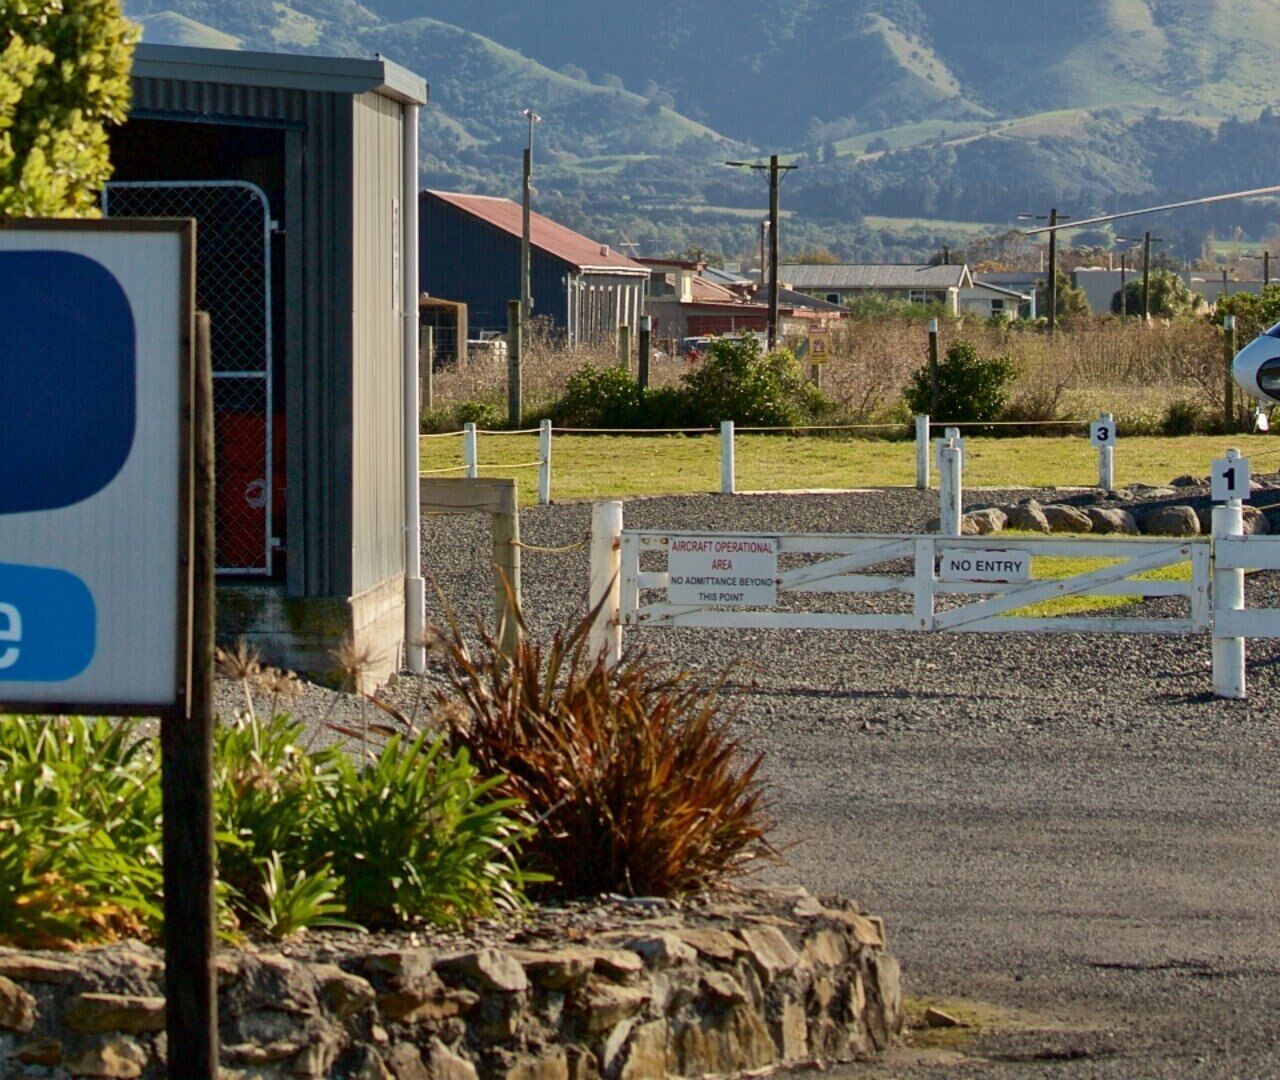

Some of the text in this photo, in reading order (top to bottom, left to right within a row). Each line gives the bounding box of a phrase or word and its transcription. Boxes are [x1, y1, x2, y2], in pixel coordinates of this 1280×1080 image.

[1096, 426, 1109, 441] 3
[1222, 467, 1236, 491] 1
[671, 540, 773, 553] AIRCRAFT OPERATIONAL
[712, 560, 733, 570] AREA
[950, 560, 1023, 573] NO ENTRY
[671, 576, 774, 587] NO ADMITTANCE BEYOND
[699, 593, 744, 602] THIS POINT
